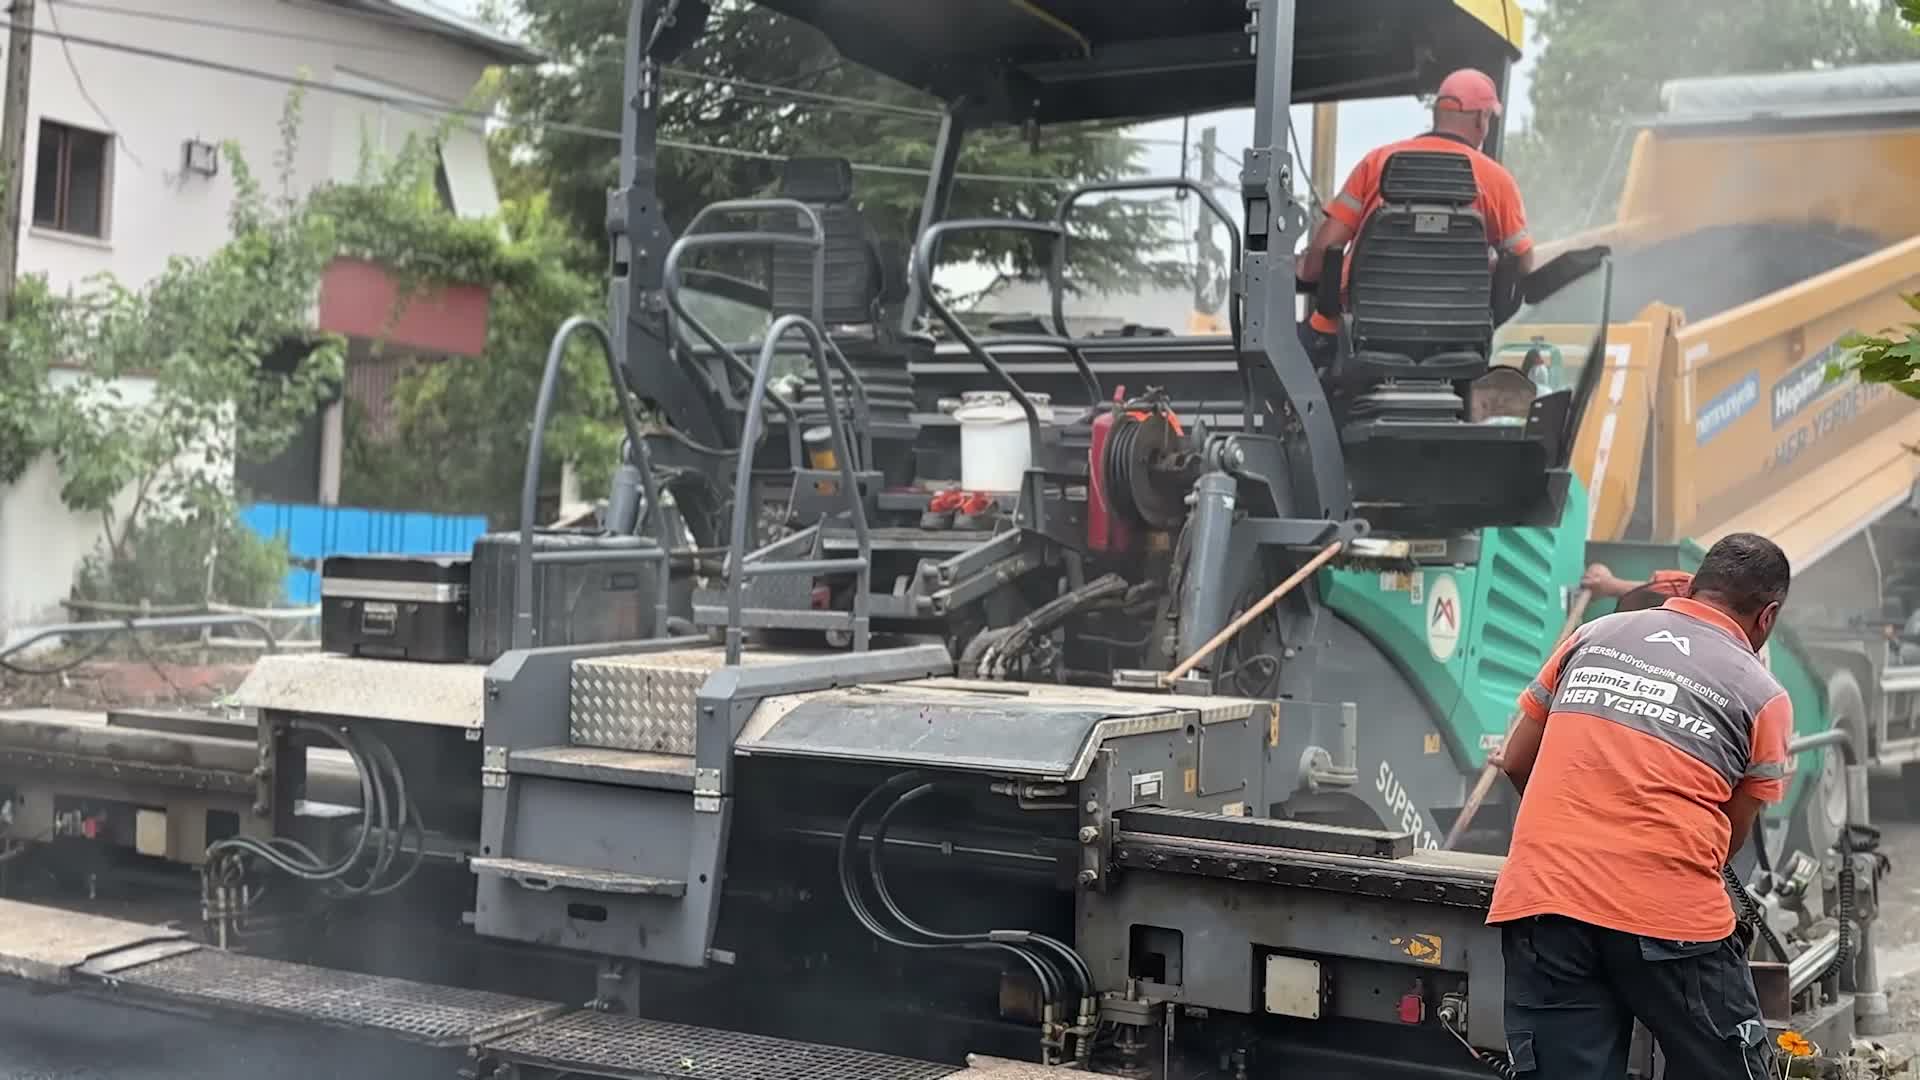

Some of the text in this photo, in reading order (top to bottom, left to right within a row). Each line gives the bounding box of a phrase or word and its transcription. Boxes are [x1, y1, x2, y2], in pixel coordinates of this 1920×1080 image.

[1573, 671, 1667, 698] Hepimiz İçin
[1560, 689, 1716, 740] HER YERDEYİZ
[1376, 760, 1422, 848] SUPER
